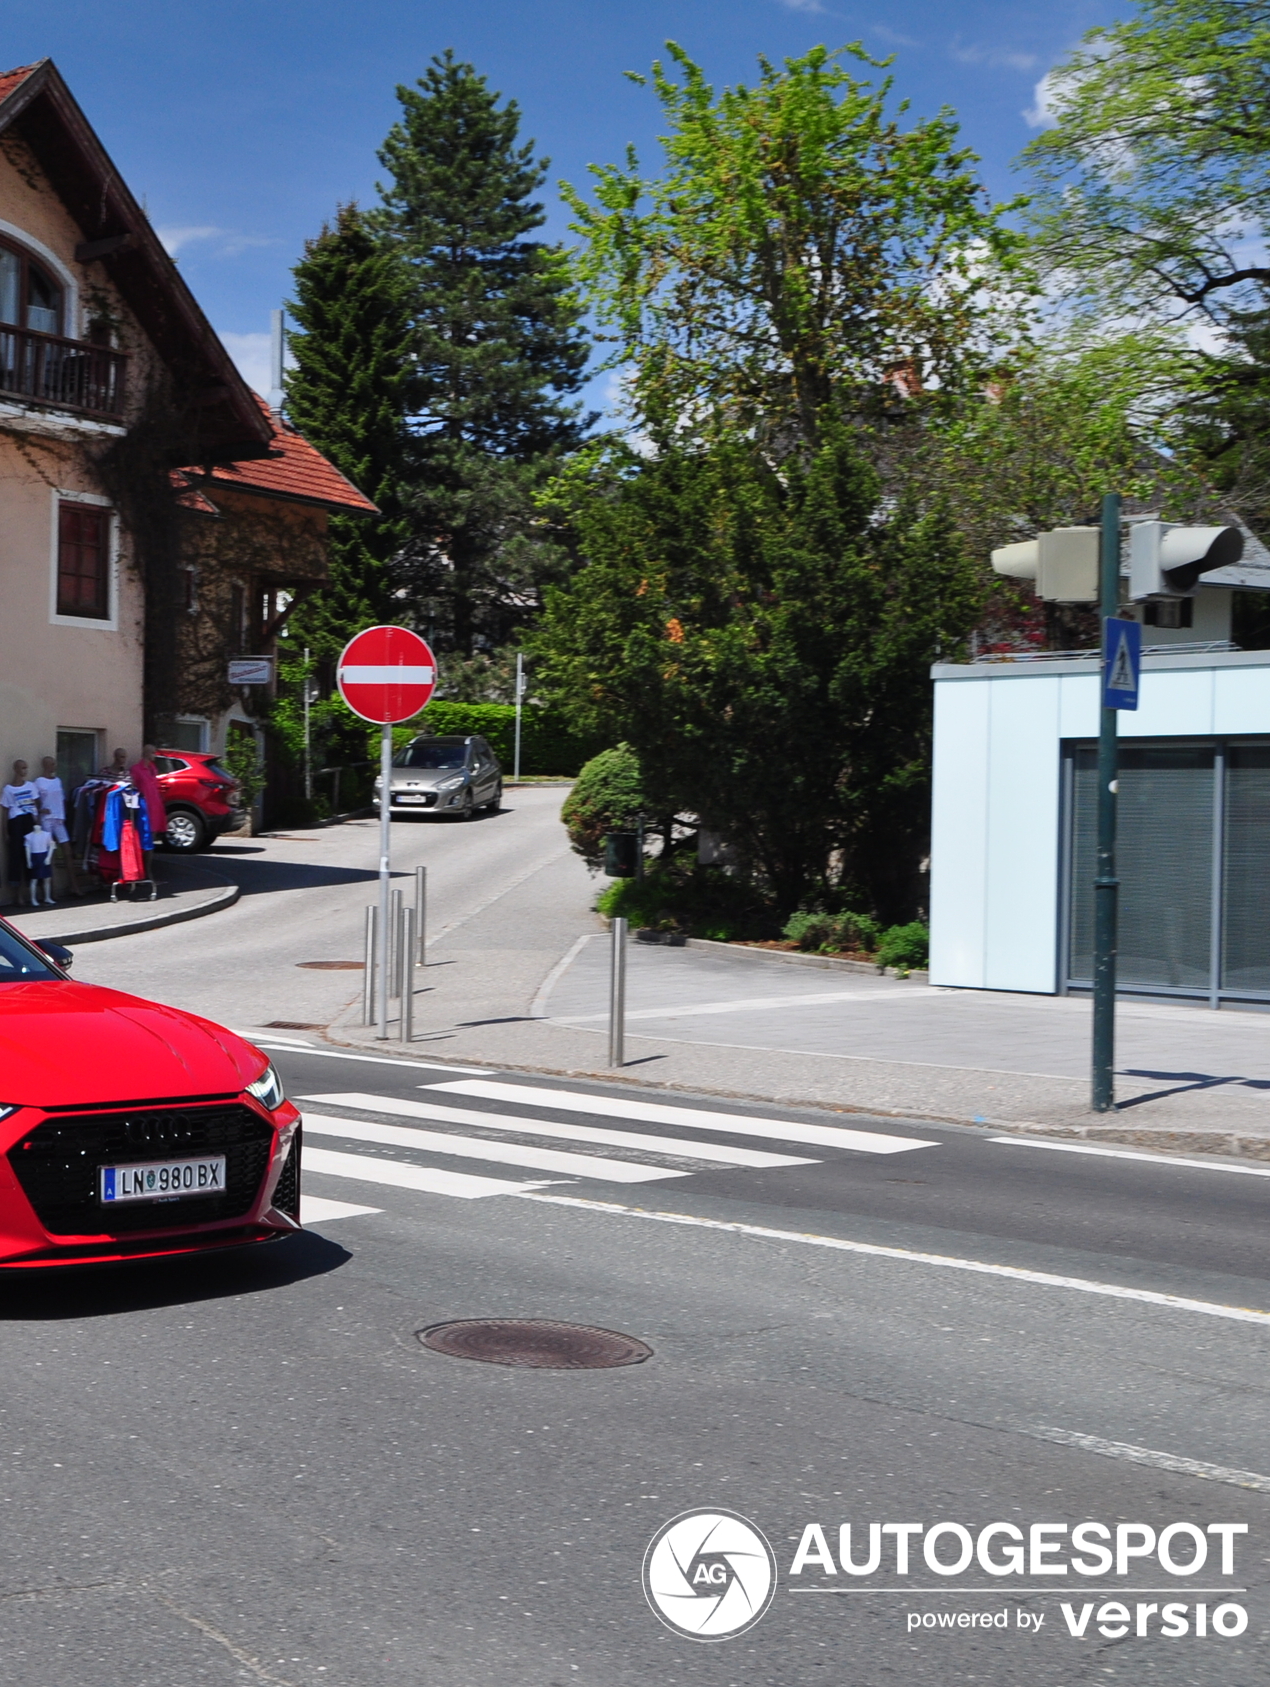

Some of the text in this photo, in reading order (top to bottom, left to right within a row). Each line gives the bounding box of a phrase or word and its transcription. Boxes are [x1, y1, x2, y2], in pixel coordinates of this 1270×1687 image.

[121, 1162, 219, 1194] LN 980 BX
